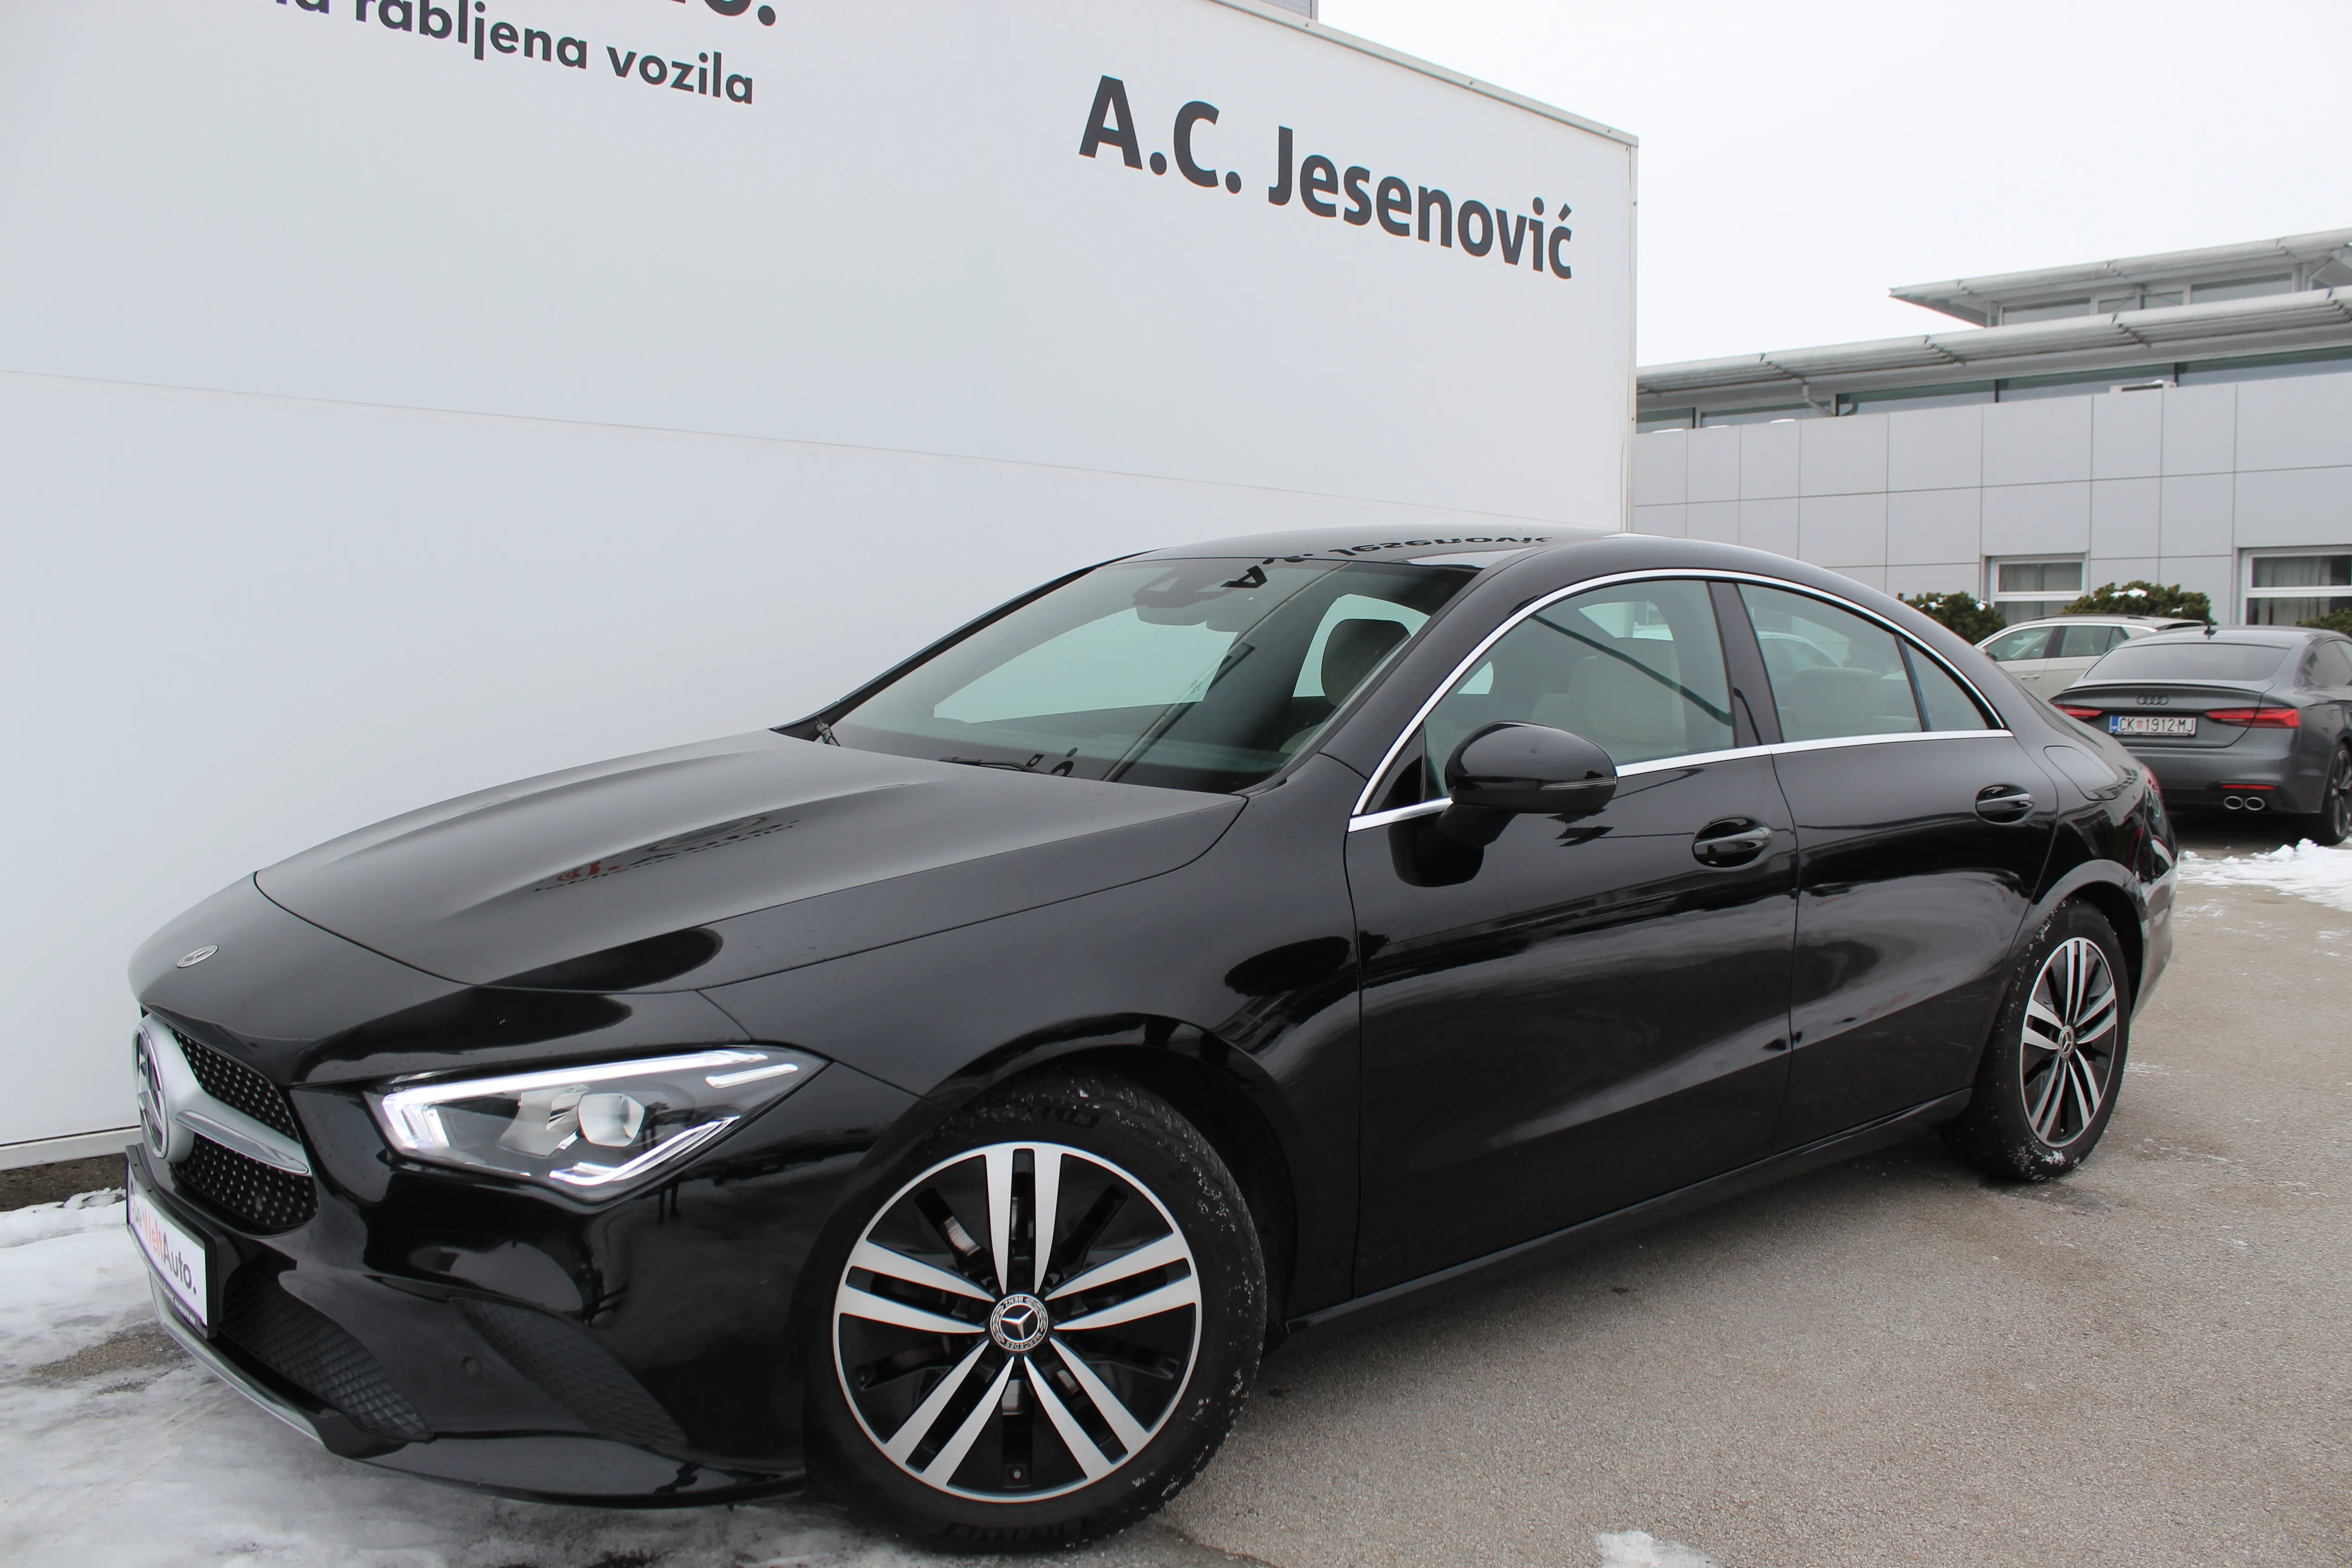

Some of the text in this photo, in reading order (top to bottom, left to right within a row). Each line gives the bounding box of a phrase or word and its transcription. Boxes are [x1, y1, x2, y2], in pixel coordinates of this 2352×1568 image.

[356, 0, 753, 104] rabljena vozila
[1079, 74, 1572, 280] A.C. Jesenović
[2119, 717, 2134, 731] CK
[1003, 1296, 1024, 1308] BENZ
[1005, 1332, 1043, 1350] MERCEDES
